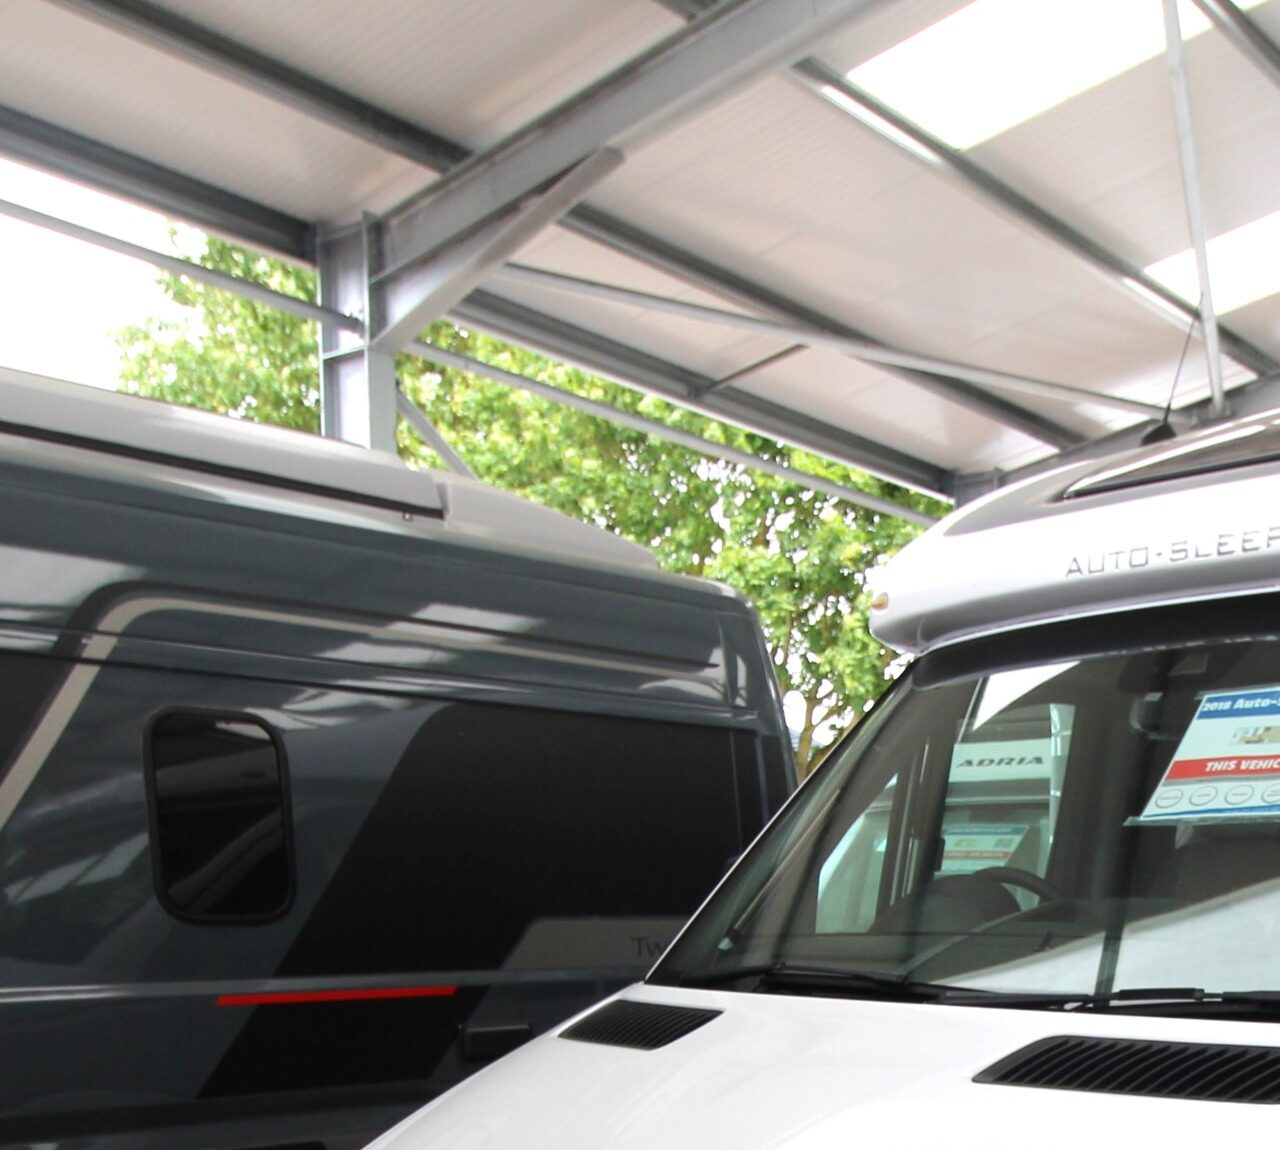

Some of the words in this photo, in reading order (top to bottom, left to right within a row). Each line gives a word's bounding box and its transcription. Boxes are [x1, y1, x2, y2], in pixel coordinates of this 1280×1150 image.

[1202, 700, 1231, 712] 2018
[958, 756, 1043, 768] ADRIA
[1205, 760, 1237, 772] THIS
